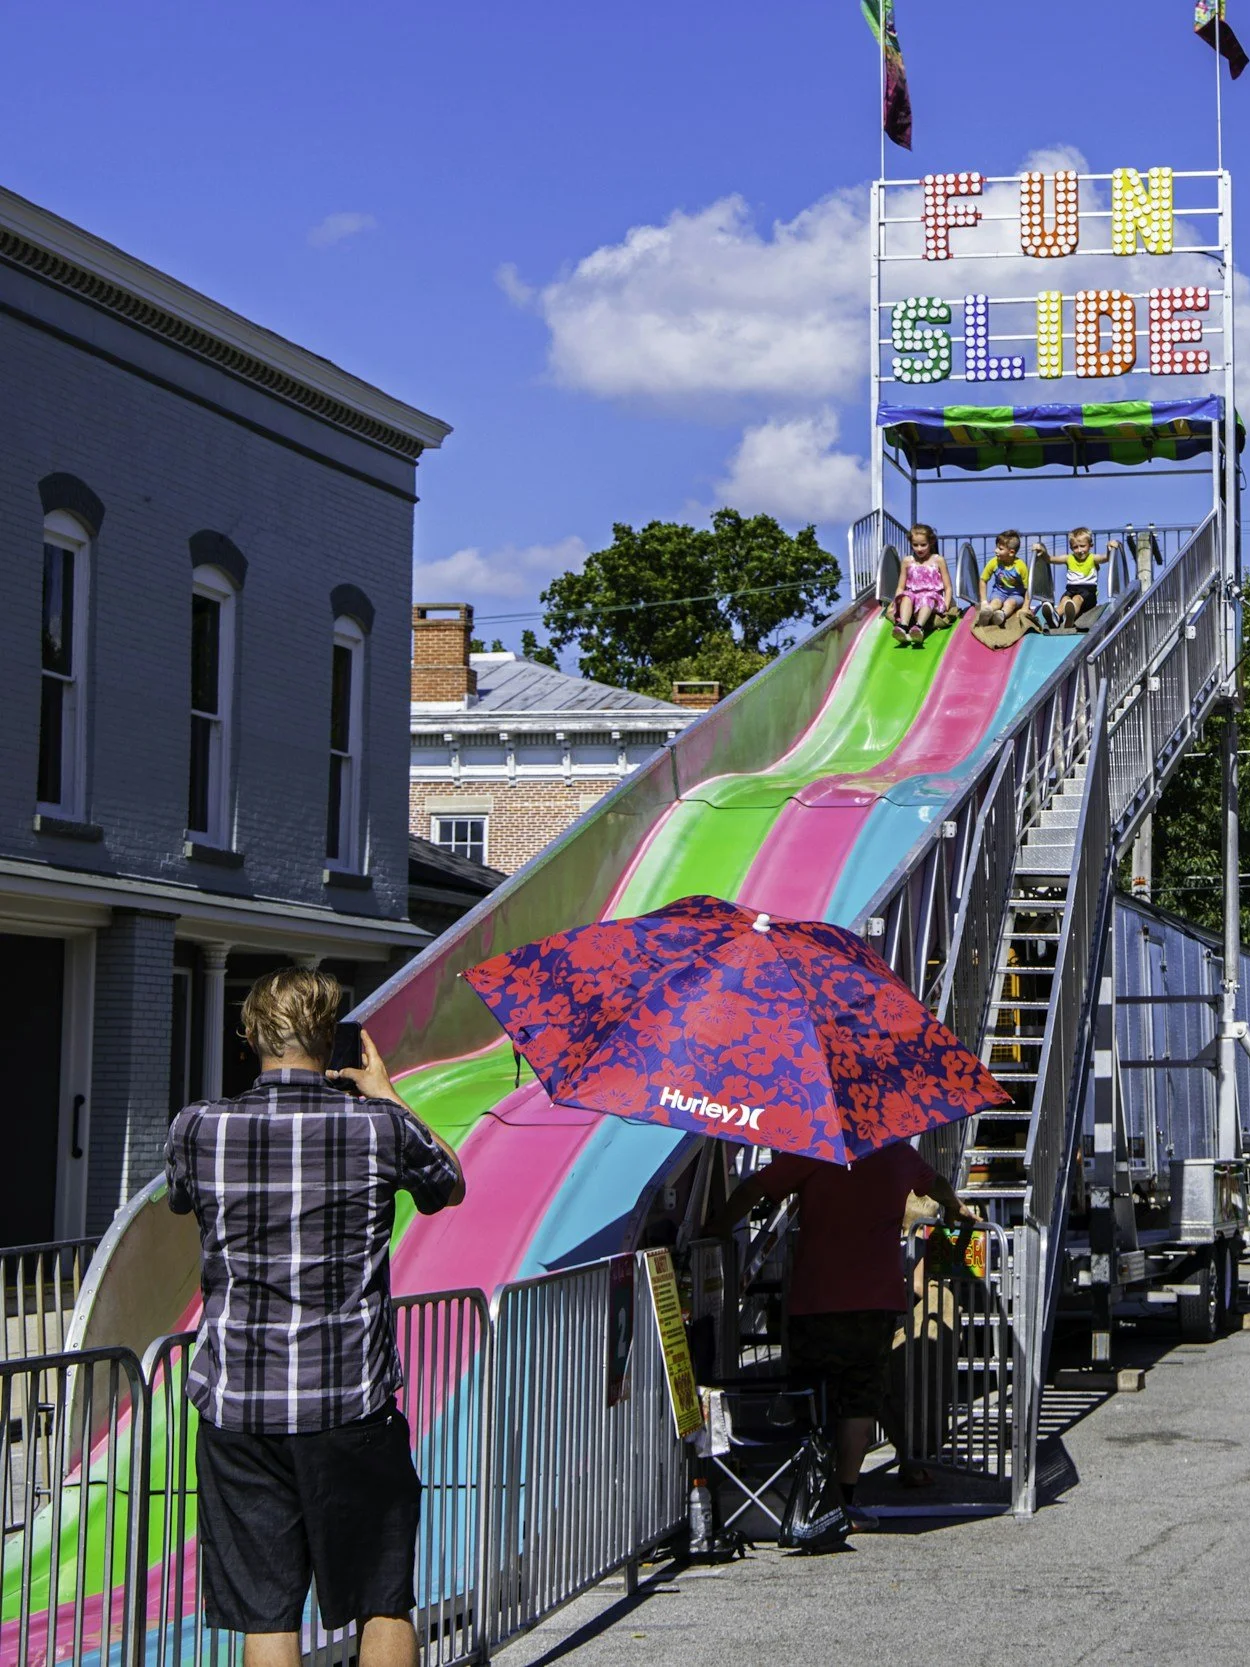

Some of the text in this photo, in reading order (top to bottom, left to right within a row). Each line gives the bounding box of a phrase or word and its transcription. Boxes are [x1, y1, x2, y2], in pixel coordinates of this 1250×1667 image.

[922, 167, 1173, 260] FUN
[891, 287, 1209, 383] SLIDE
[660, 1086, 738, 1123] Hurley
